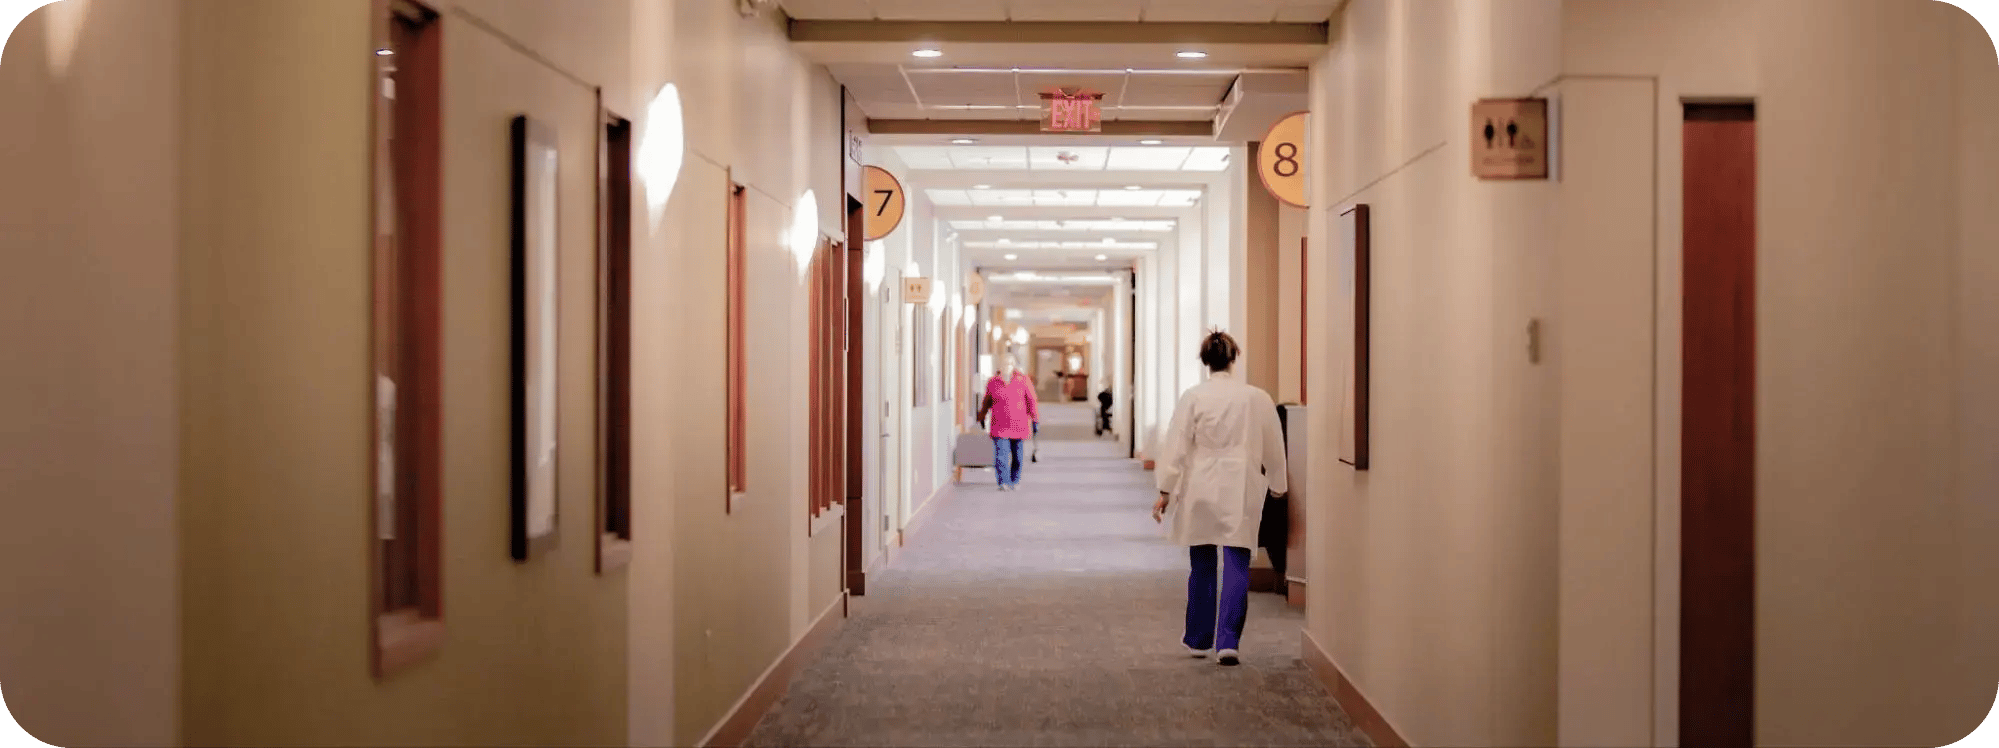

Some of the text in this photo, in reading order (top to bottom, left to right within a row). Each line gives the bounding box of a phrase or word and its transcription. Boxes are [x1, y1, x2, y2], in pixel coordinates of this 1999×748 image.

[1052, 100, 1093, 128] EXIT
[1273, 142, 1299, 177] 8
[874, 190, 893, 217] 7
